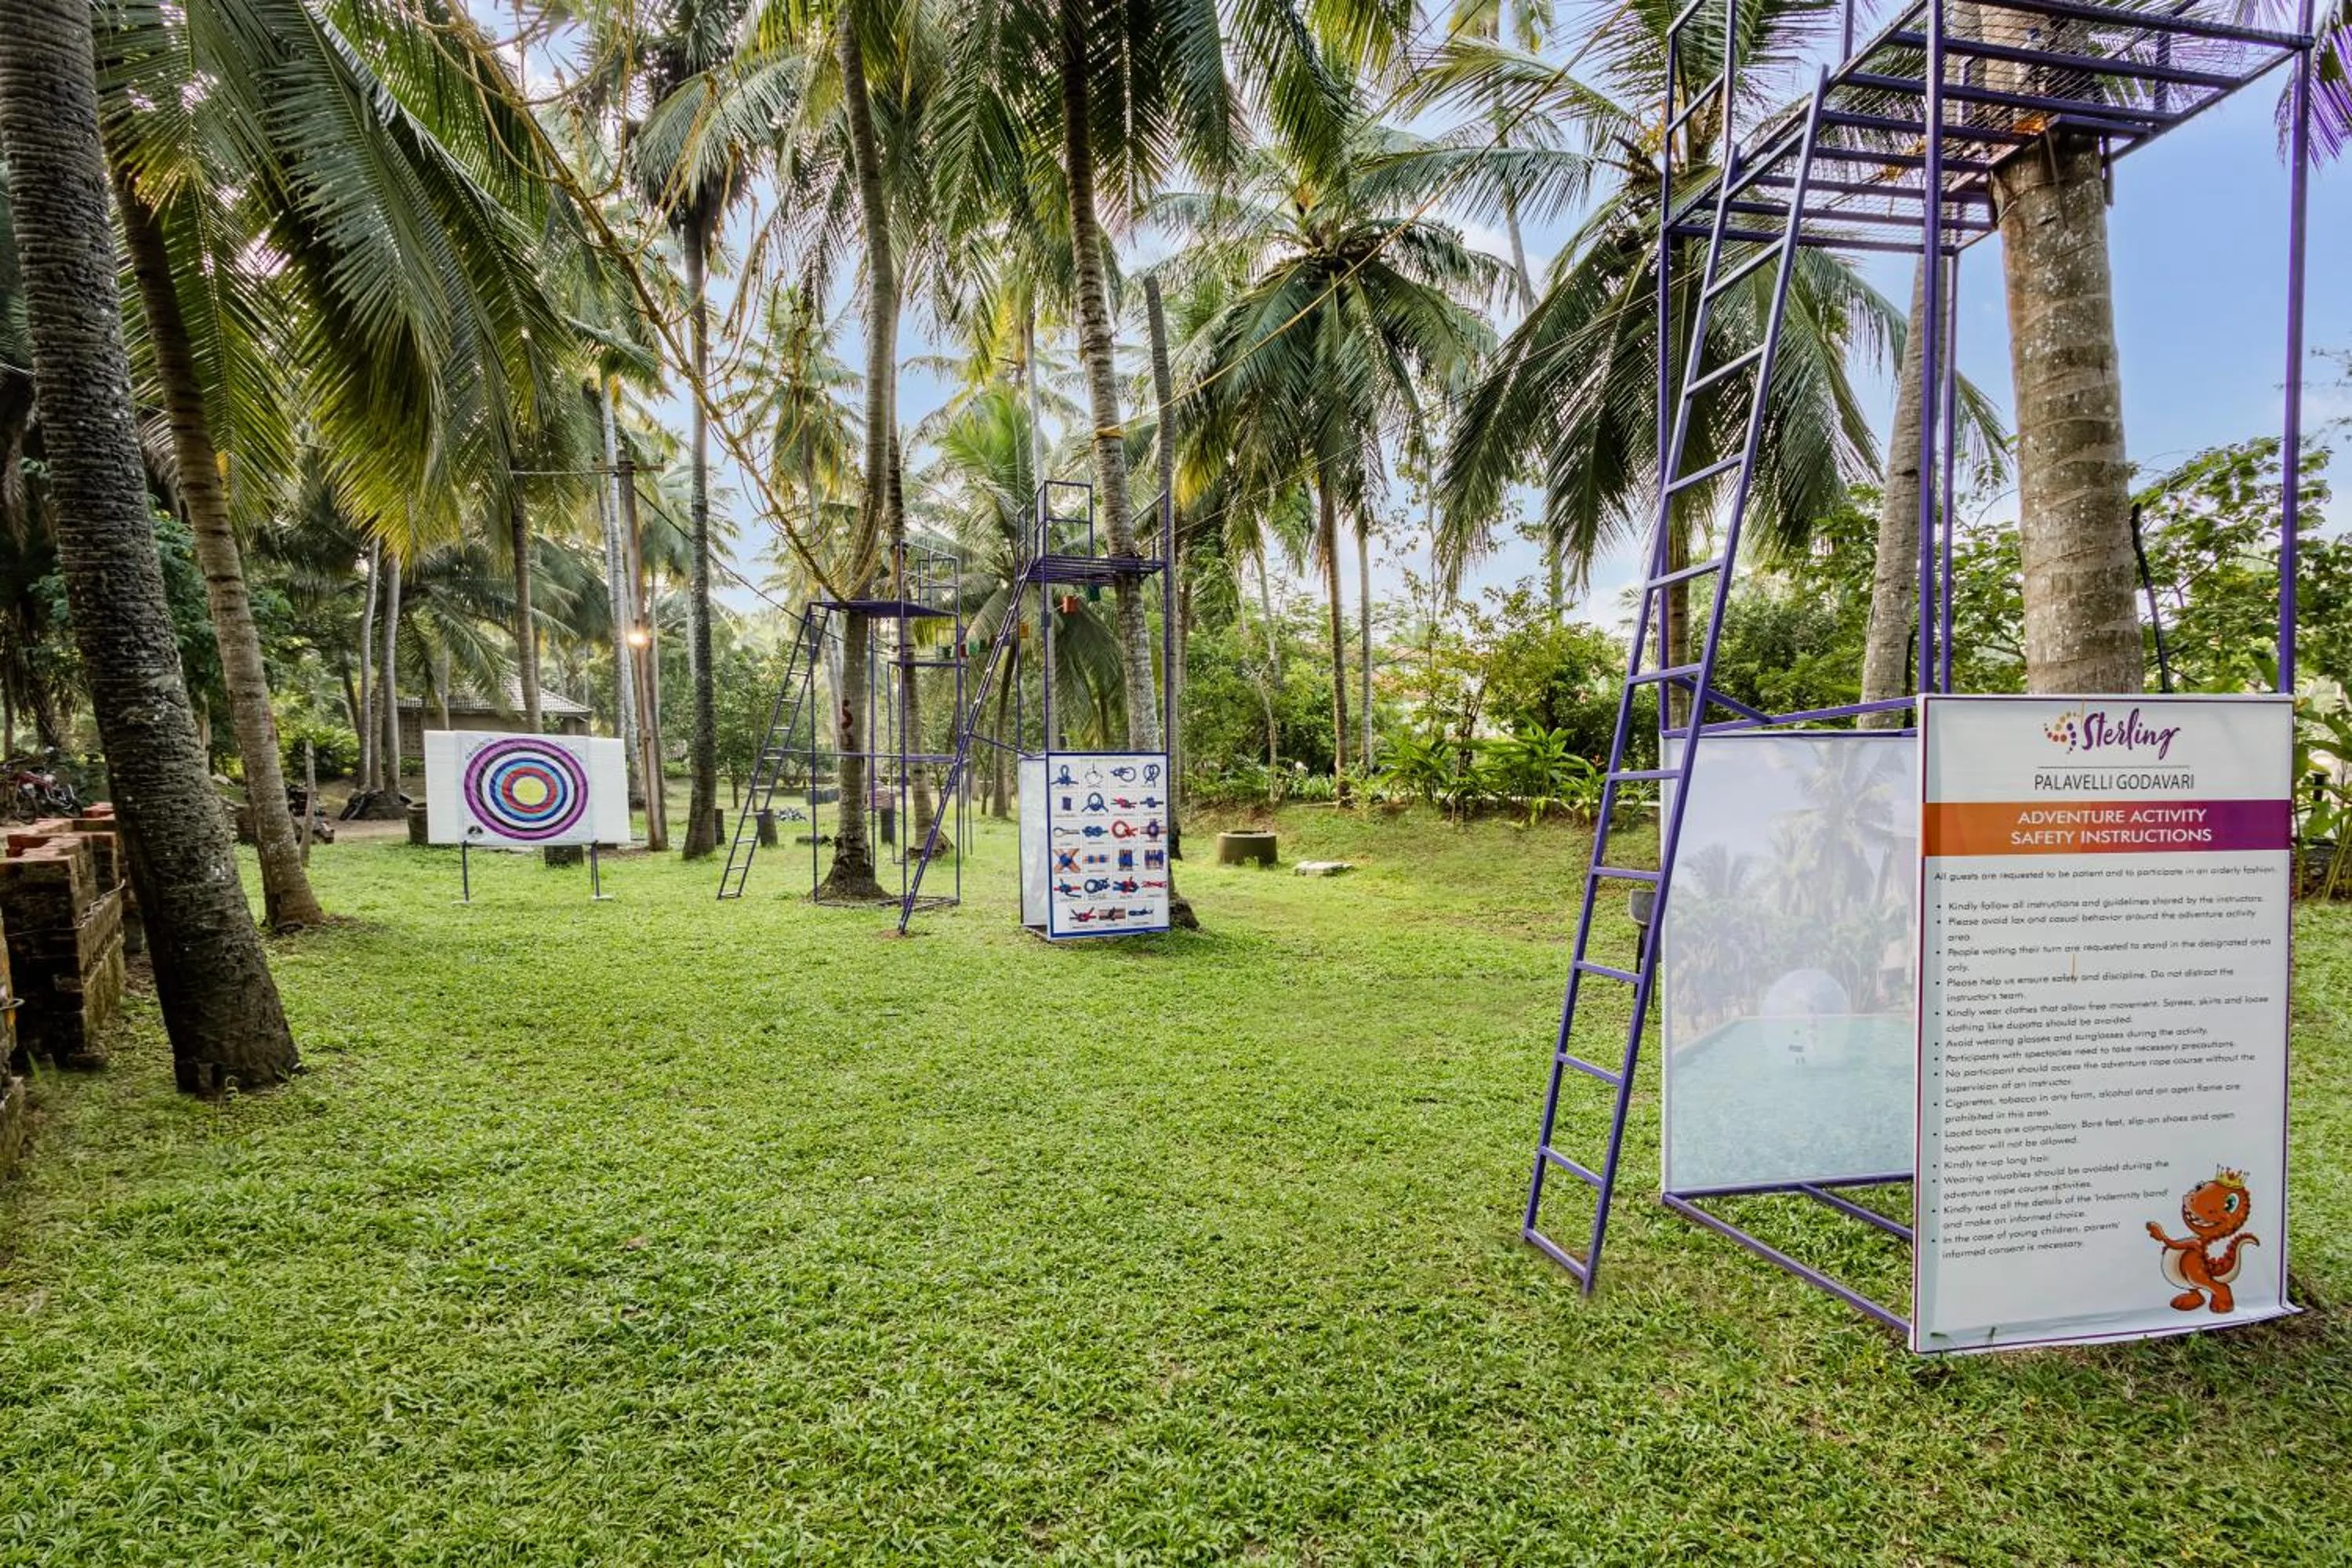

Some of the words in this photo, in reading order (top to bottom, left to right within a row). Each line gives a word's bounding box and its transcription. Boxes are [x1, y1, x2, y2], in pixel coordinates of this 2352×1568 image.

[2082, 708, 2180, 760] Sterling
[2034, 775, 2112, 790] PALAVELLI
[2117, 774, 2194, 789] GODAVARI
[2018, 810, 2125, 824] ADVENTURE
[2130, 808, 2207, 822] ACTIVITY
[2010, 830, 2074, 844] SAFETY
[2080, 829, 2212, 843] INSTRUCTIONS
[1934, 870, 1947, 880] All
[1949, 871, 1979, 883] guests
[2105, 868, 2123, 877] and
[2136, 866, 2183, 878] participate
[1948, 900, 1977, 912] Kindly
[1980, 900, 2009, 909] follow
[2012, 899, 2024, 909] all
[2027, 898, 2079, 909] instructions
[2082, 898, 2100, 907] and
[2102, 896, 2150, 909] guidelines
[2151, 895, 2183, 905] shared
[2199, 894, 2214, 904] the
[1948, 916, 1979, 926] Please
[1981, 915, 2009, 925] avoid
[2010, 915, 2025, 924] lax
[2027, 914, 2047, 924] and
[2049, 913, 2079, 924] casual
[2082, 912, 2122, 922] behavior
[2161, 909, 2176, 920] the
[2177, 909, 2223, 919] adventure
[2225, 908, 2256, 920] activity
[1947, 946, 1980, 958] People
[1982, 946, 2017, 957] waiting
[2019, 944, 2040, 954] their
[2142, 939, 2168, 949] stand
[2181, 938, 2196, 948] the
[2249, 938, 2271, 946] area
[1947, 977, 1977, 987] Please
[1980, 976, 2002, 988] help
[2081, 971, 2100, 982] and
[2166, 968, 2183, 978] not
[2183, 967, 2218, 977] distract
[2219, 966, 2234, 976] the
[1947, 1007, 1976, 1018] Kindly
[2005, 1004, 2038, 1014] clothes
[2039, 1003, 2059, 1012] that
[2060, 1001, 2086, 1011] allow
[2088, 1000, 2107, 1011] free
[2224, 995, 2243, 1004] and
[2245, 993, 2269, 1004] loose
[1946, 1022, 1984, 1034] clothing
[2045, 1017, 2077, 1027] should
[1946, 1037, 1973, 1047] Avoid
[1976, 1036, 2014, 1048] wearing
[2016, 1033, 2051, 1046] glasses
[2053, 1032, 2072, 1042] and
[2074, 1029, 2124, 1043] sunglasses
[2126, 1028, 2157, 1040] during
[2158, 1026, 2173, 1036] the
[1945, 1051, 2000, 1064] Participants
[2002, 1049, 2022, 1059] with
[2074, 1045, 2098, 1055] need
[2111, 1044, 2132, 1054] take
[1963, 1065, 2014, 1078] participant
[2016, 1063, 2049, 1073] should
[2050, 1063, 2081, 1072] access
[2083, 1060, 2099, 1069] the
[2100, 1058, 2147, 1069] adventure
[2149, 1058, 2171, 1069] rope
[2172, 1057, 2203, 1065] course
[2205, 1052, 2239, 1063] without
[2240, 1051, 2255, 1062] the
[1945, 1081, 1998, 1094] supervision
[1998, 1094, 2037, 1105] tobacco
[2050, 1094, 2068, 1103] any
[2098, 1087, 2133, 1098] alcohol
[2135, 1086, 2154, 1096] and
[2170, 1086, 2194, 1096] open
[2225, 1083, 2241, 1091] are
[1944, 1127, 1973, 1138] Laced
[1975, 1125, 2002, 1136] boots
[2081, 1118, 2103, 1128] Bare
[2161, 1112, 2188, 1123] shoes
[2190, 1111, 2209, 1121] and
[1945, 1111, 1994, 1124] prohibited
[2008, 1109, 2024, 1119] this
[1988, 1139, 2005, 1149] will
[2006, 1138, 2023, 1149] not
[1944, 1159, 1973, 1171] Kindly
[2006, 1155, 2027, 1167] long
[1944, 1173, 1984, 1186] Wearing
[1986, 1169, 2031, 1181] valuables
[2034, 1166, 2065, 1177] should
[2082, 1162, 2120, 1174] avoided
[2122, 1160, 2152, 1173] during
[2154, 1158, 2169, 1168] the
[1944, 1187, 1991, 1200] adventure
[1994, 1187, 2015, 1197] rope
[2017, 1185, 2049, 1193] course
[1944, 1203, 1973, 1216] Kindly
[1975, 1201, 1998, 1212] read
[2000, 1200, 2012, 1210] all
[2014, 1198, 2029, 1208] the
[2077, 1192, 2092, 1203] the
[1944, 1219, 1962, 1229] and
[1964, 1216, 1991, 1227] make
[2009, 1211, 2052, 1223] informed
[1955, 1232, 1969, 1243] the
[1972, 1233, 1994, 1242] case
[2009, 1230, 2038, 1240] young
[1942, 1247, 1986, 1259] informed
